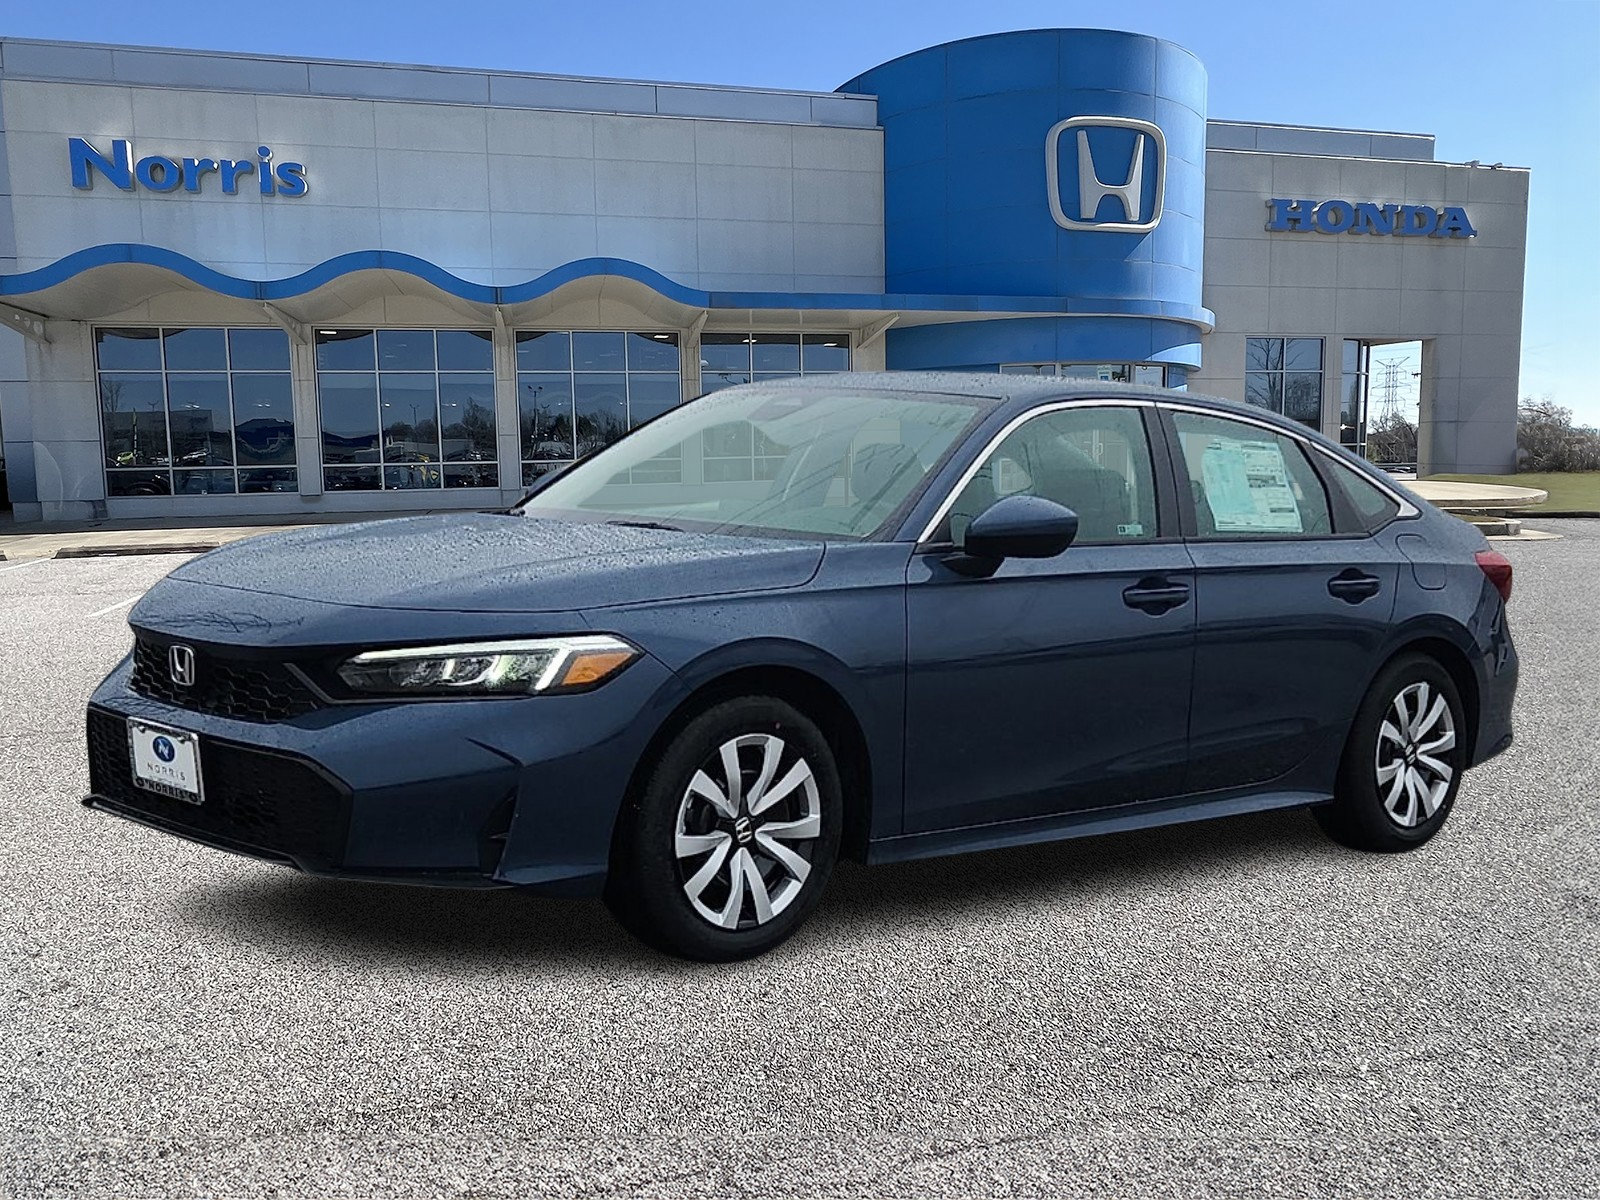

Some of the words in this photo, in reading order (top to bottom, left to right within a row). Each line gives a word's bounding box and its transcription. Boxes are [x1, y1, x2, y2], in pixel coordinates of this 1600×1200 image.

[68, 137, 308, 197] Norris
[1265, 198, 1477, 239] HONDA
[147, 762, 186, 781] NORRIS
